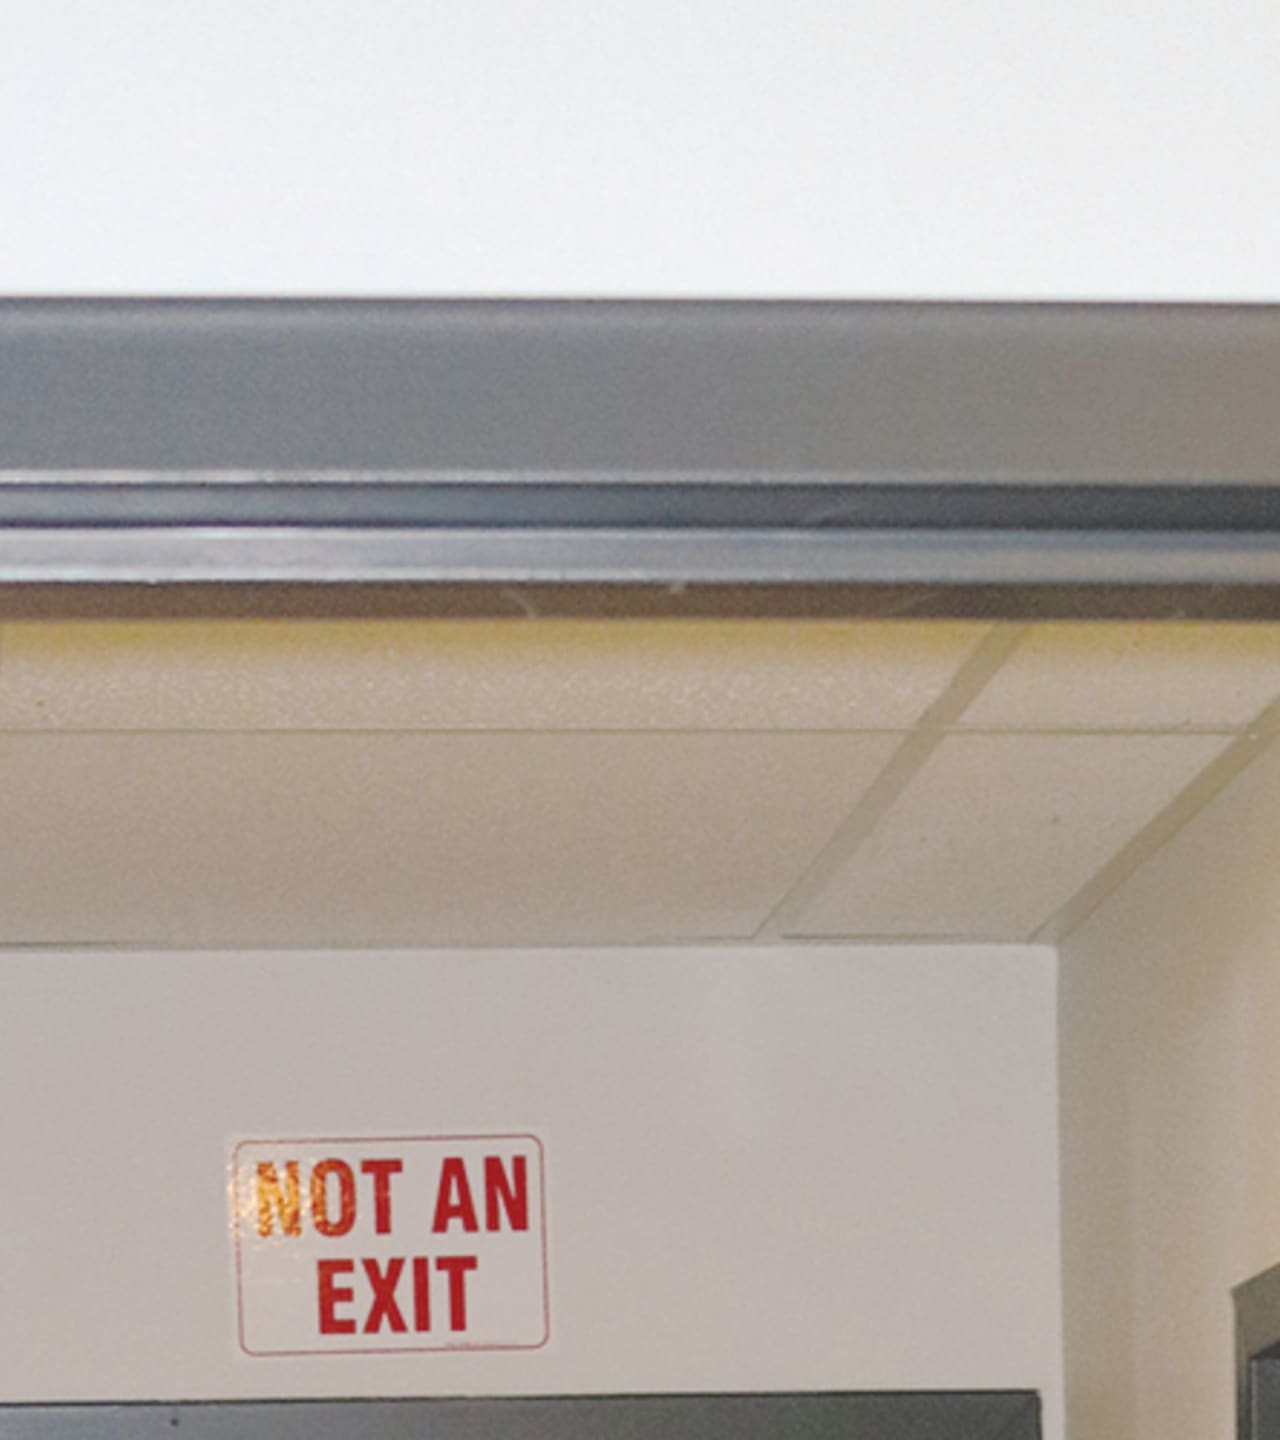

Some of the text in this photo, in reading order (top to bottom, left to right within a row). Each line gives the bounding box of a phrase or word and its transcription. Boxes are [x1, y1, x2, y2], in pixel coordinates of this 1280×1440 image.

[256, 1155, 529, 1238] NOT AN
[317, 1255, 478, 1335] EXIT
